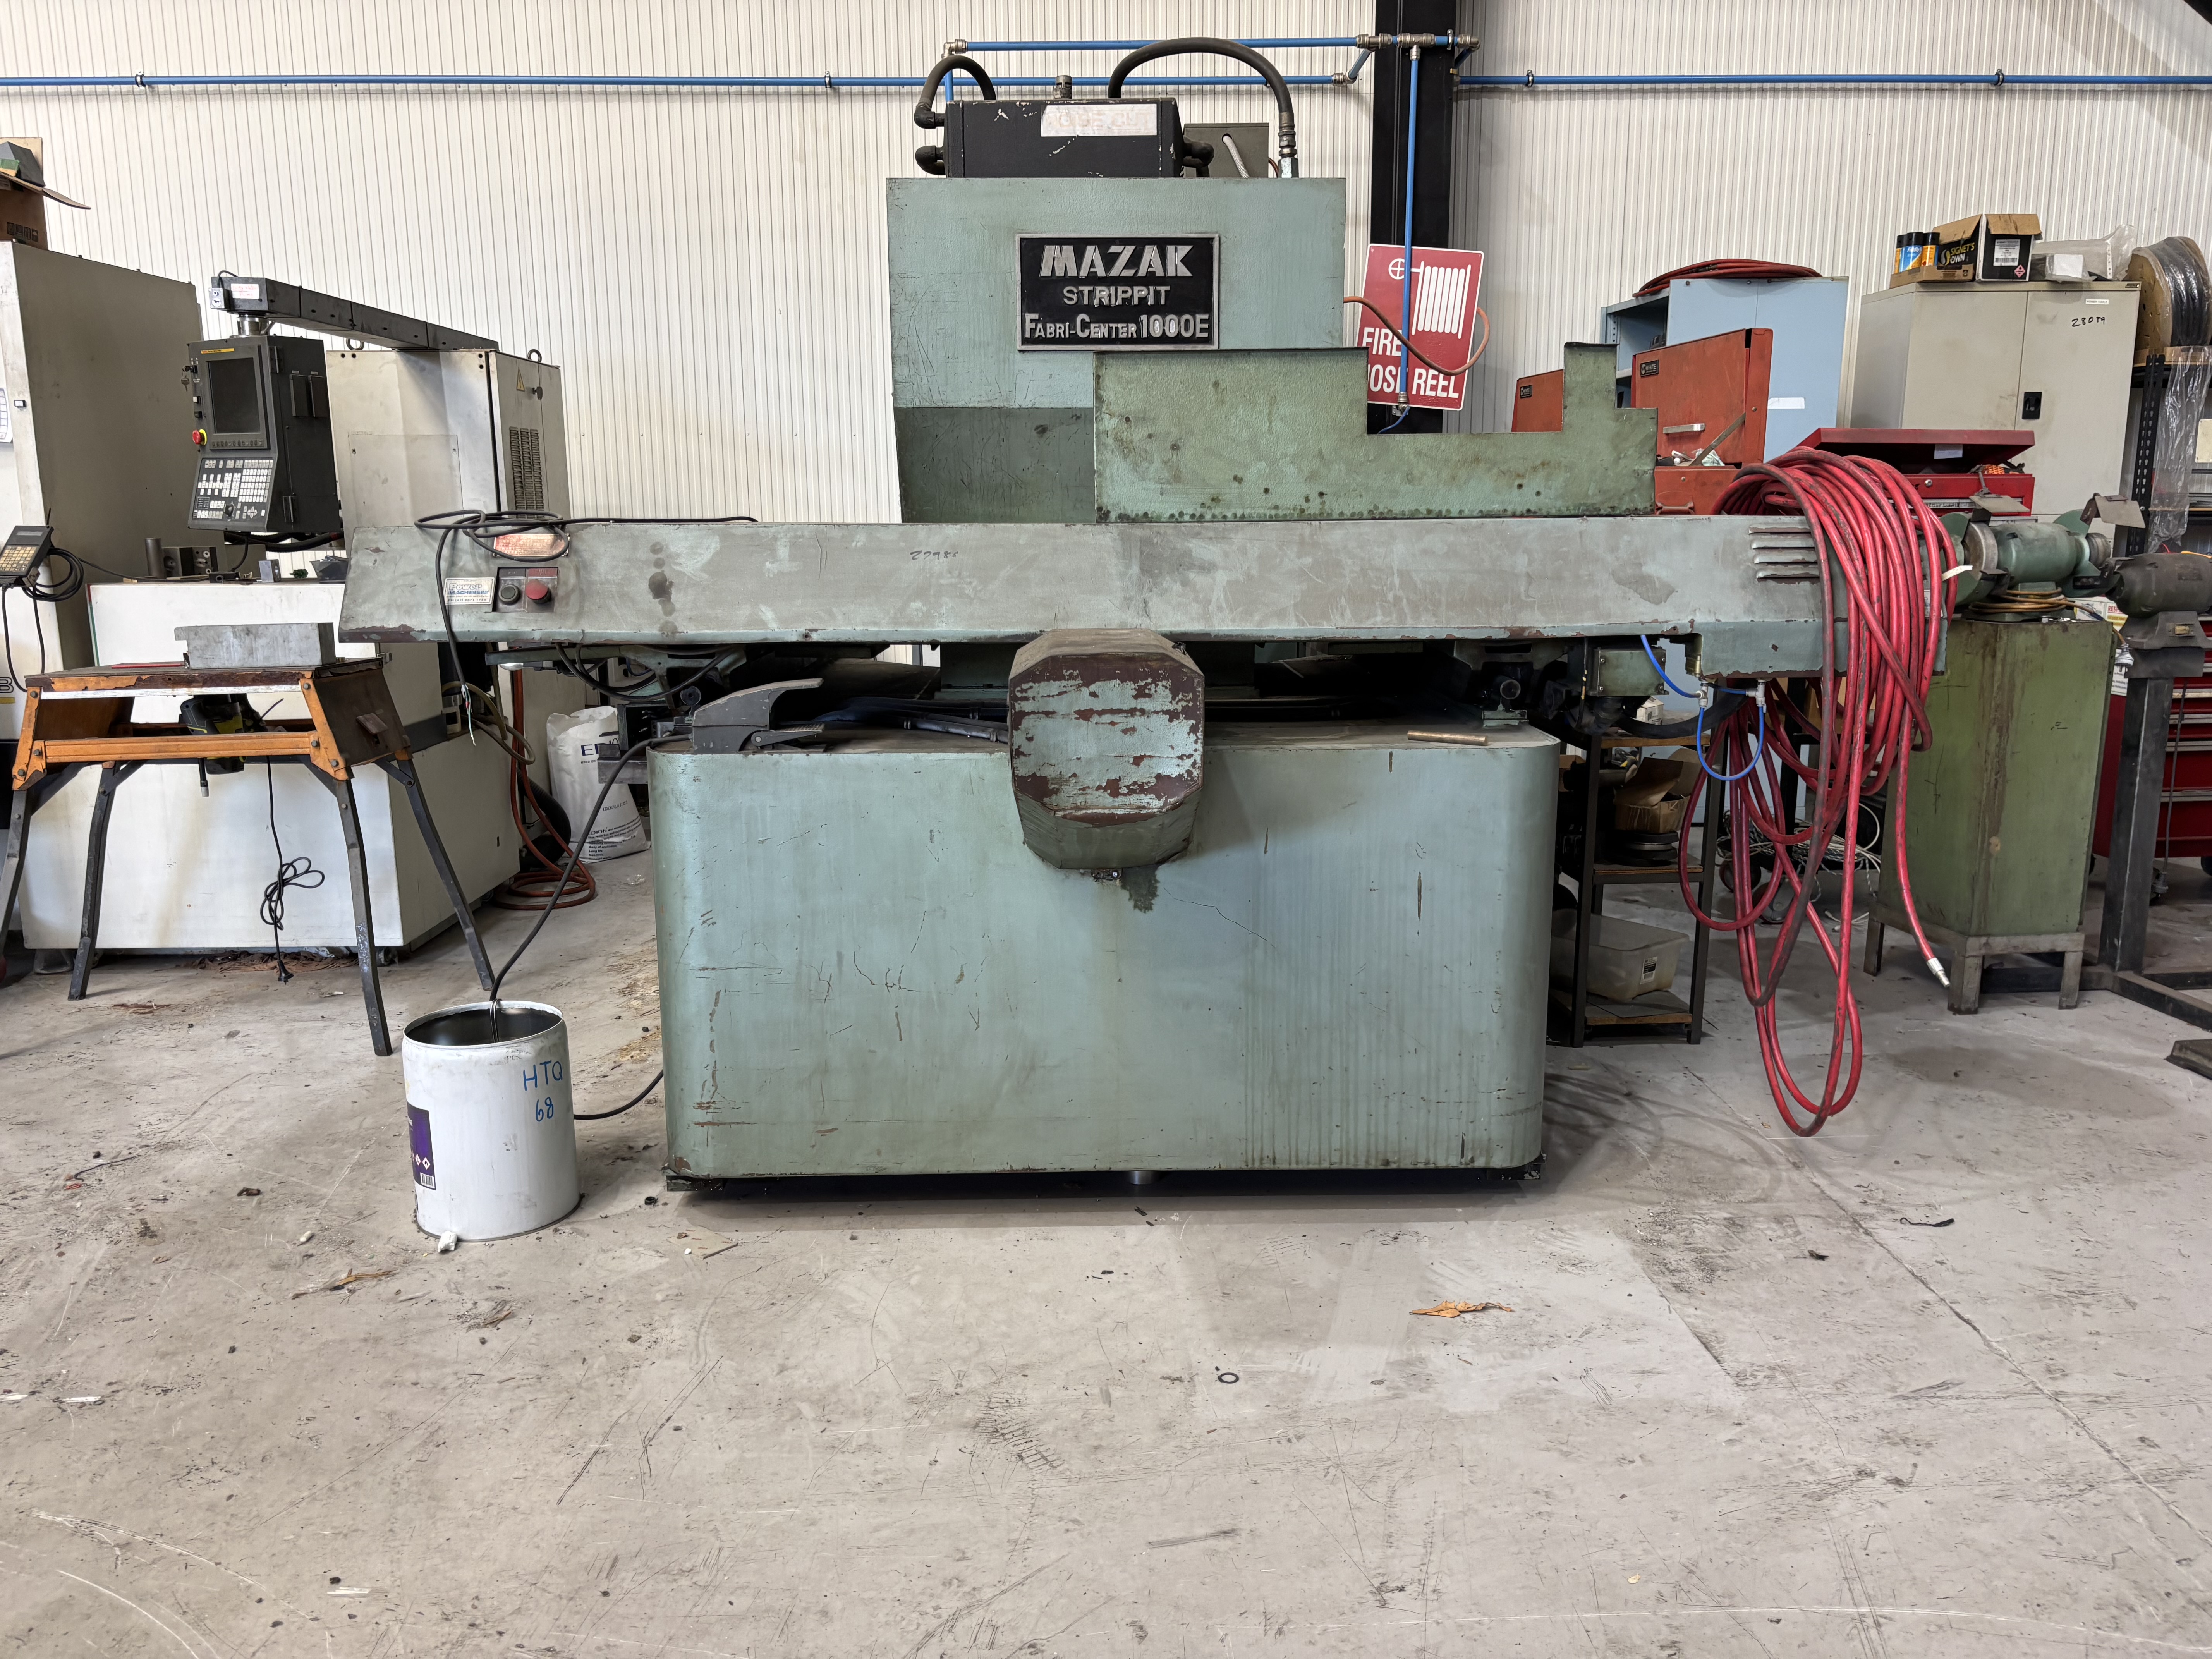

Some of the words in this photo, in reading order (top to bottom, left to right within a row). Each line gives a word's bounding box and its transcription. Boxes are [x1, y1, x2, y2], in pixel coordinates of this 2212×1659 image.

[1040, 245, 1194, 278] MAZAK
[1950, 242, 1975, 256] SIGNET'S
[1950, 253, 1965, 264] OWN
[1063, 285, 1170, 307] STRIPPIT
[1139, 314, 1209, 338] 1000E
[1362, 327, 1403, 357] FIRE
[1367, 364, 1408, 393] OS
[1412, 368, 1459, 398] REEL
[523, 1060, 563, 1091] HTQ
[536, 1096, 554, 1122] 68
